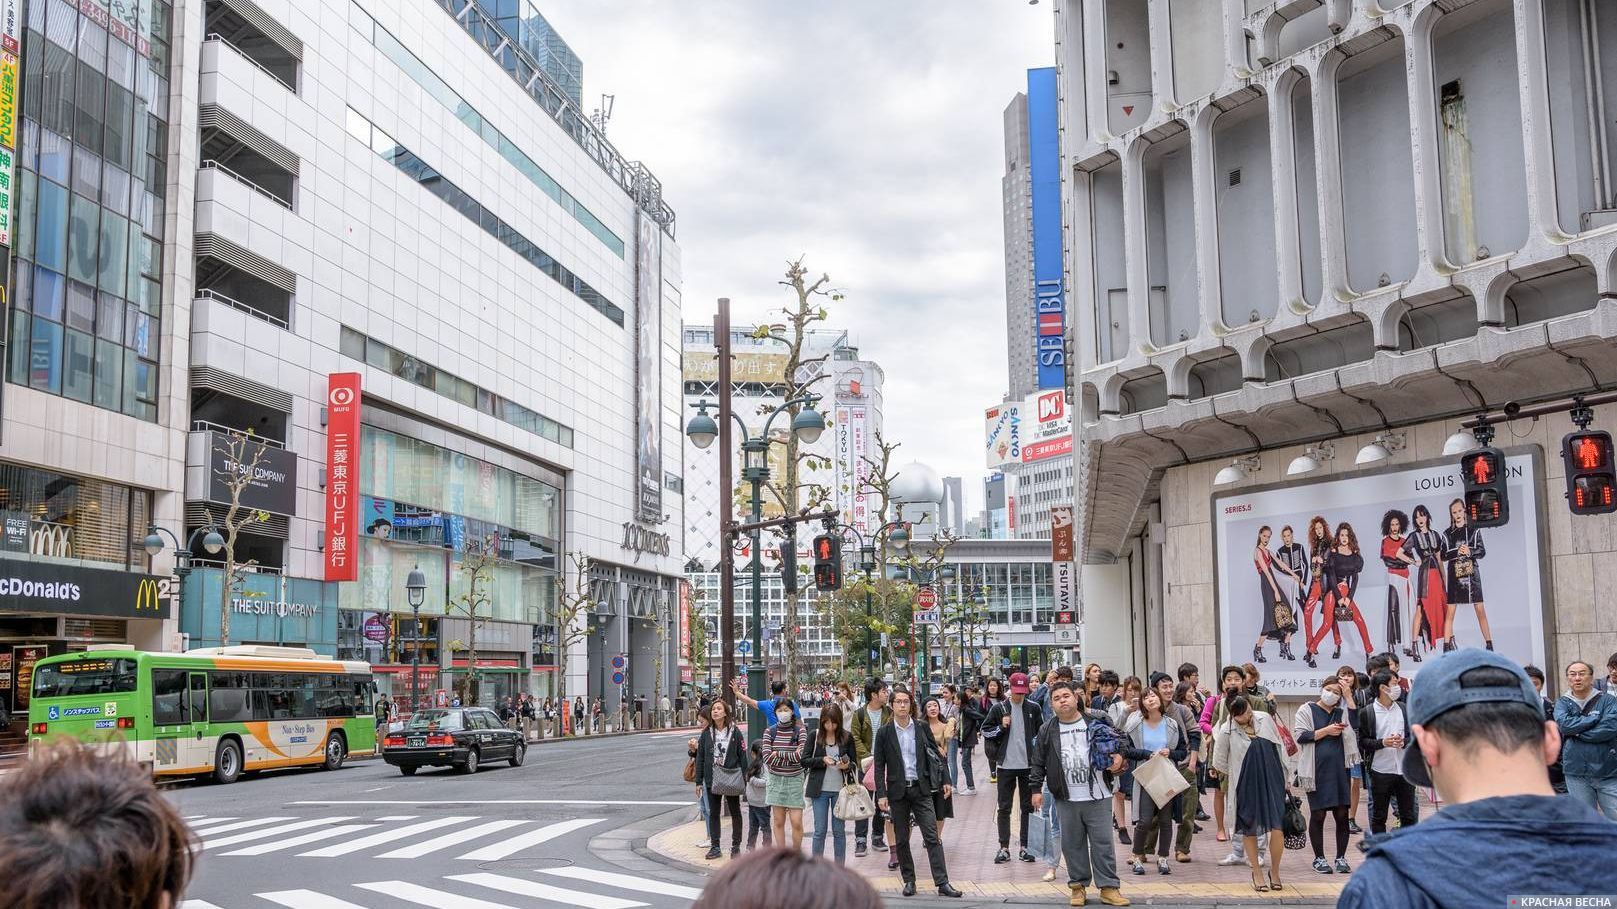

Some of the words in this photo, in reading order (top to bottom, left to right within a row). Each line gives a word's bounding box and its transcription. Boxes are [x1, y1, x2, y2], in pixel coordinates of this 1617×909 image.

[4, 53, 14, 64] 4F
[1038, 278, 1065, 366] SEIBU
[1040, 394, 1061, 419] DC
[986, 410, 1009, 450] SANKYO
[1011, 408, 1021, 458] SANKYO
[254, 467, 286, 483] COMPANY
[1415, 475, 1455, 491] LOUIS
[331, 433, 348, 567] 三菱東京UFJ銀行
[1225, 504, 1252, 514] SERIES.5
[6, 518, 27, 528] FREE
[1059, 562, 1070, 611] TSUTAYA
[232, 598, 252, 613] THE
[254, 600, 275, 615] SUIT
[63, 707, 101, 716] ノンステップバス
